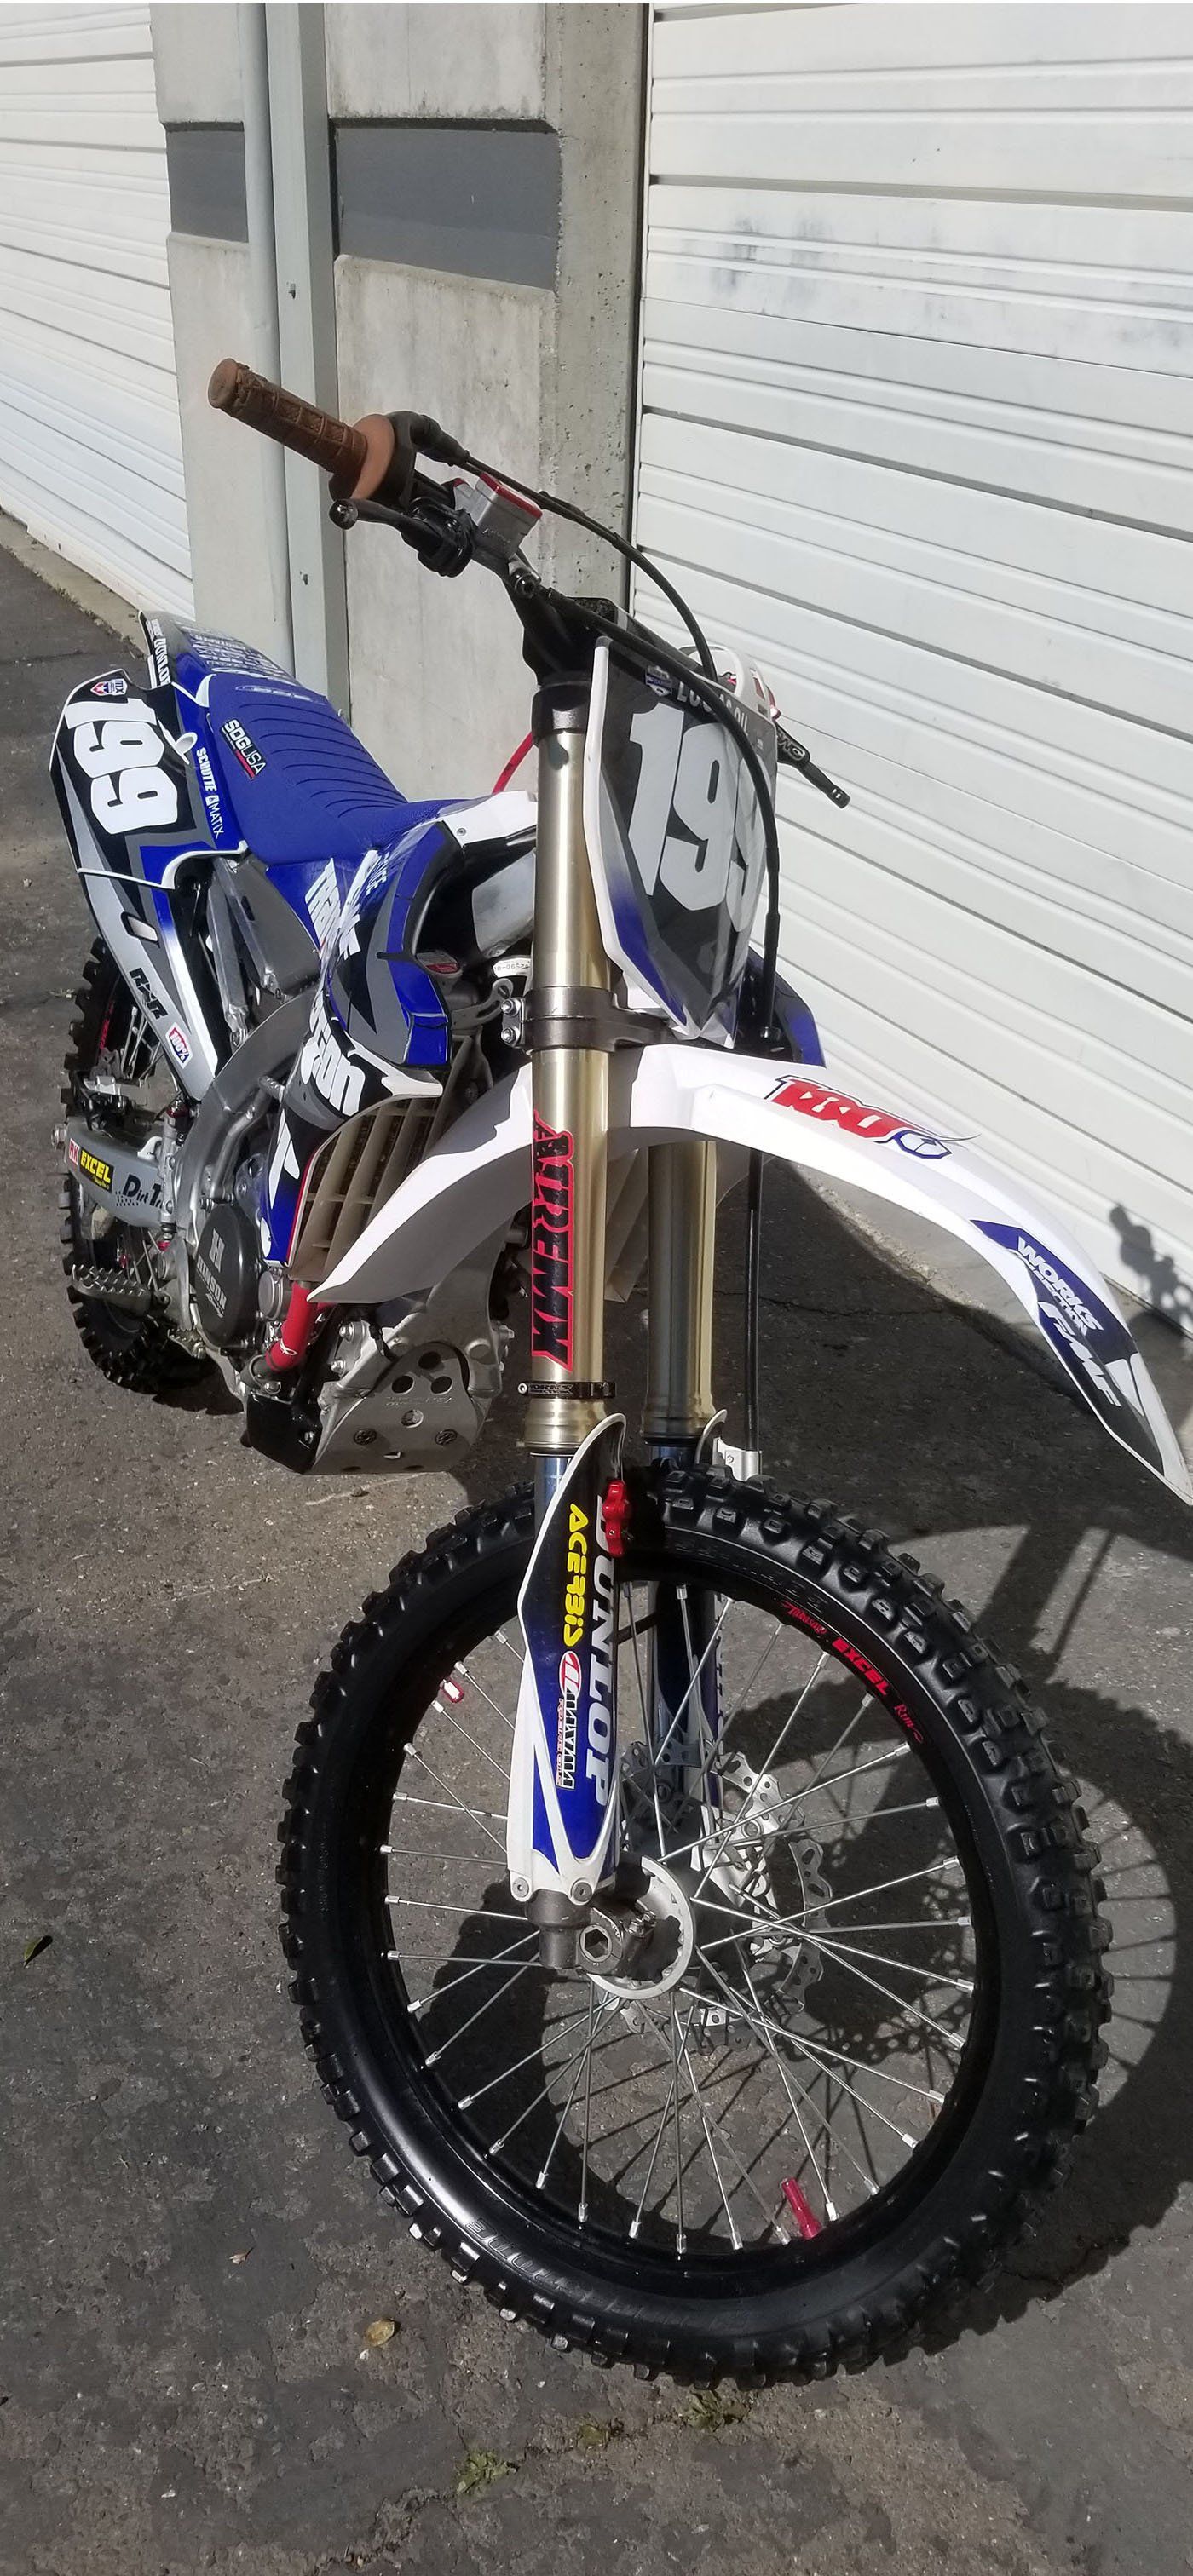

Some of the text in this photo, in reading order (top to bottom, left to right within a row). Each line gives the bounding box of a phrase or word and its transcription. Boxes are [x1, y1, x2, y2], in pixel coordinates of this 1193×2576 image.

[64, 698, 178, 835] 199
[208, 802, 225, 840] MATIX
[628, 702, 767, 934] 199
[170, 1031, 190, 1063] 100%
[80, 1150, 111, 1184] EXCEL
[197, 1253, 227, 1310] HINSON
[1017, 1235, 1105, 1331] WORKS
[1037, 1301, 1122, 1407] FMF
[563, 1503, 590, 1647] ACERBIS
[831, 1636, 890, 1696] EXCEL
[562, 1665, 579, 1790] MAXIMA
